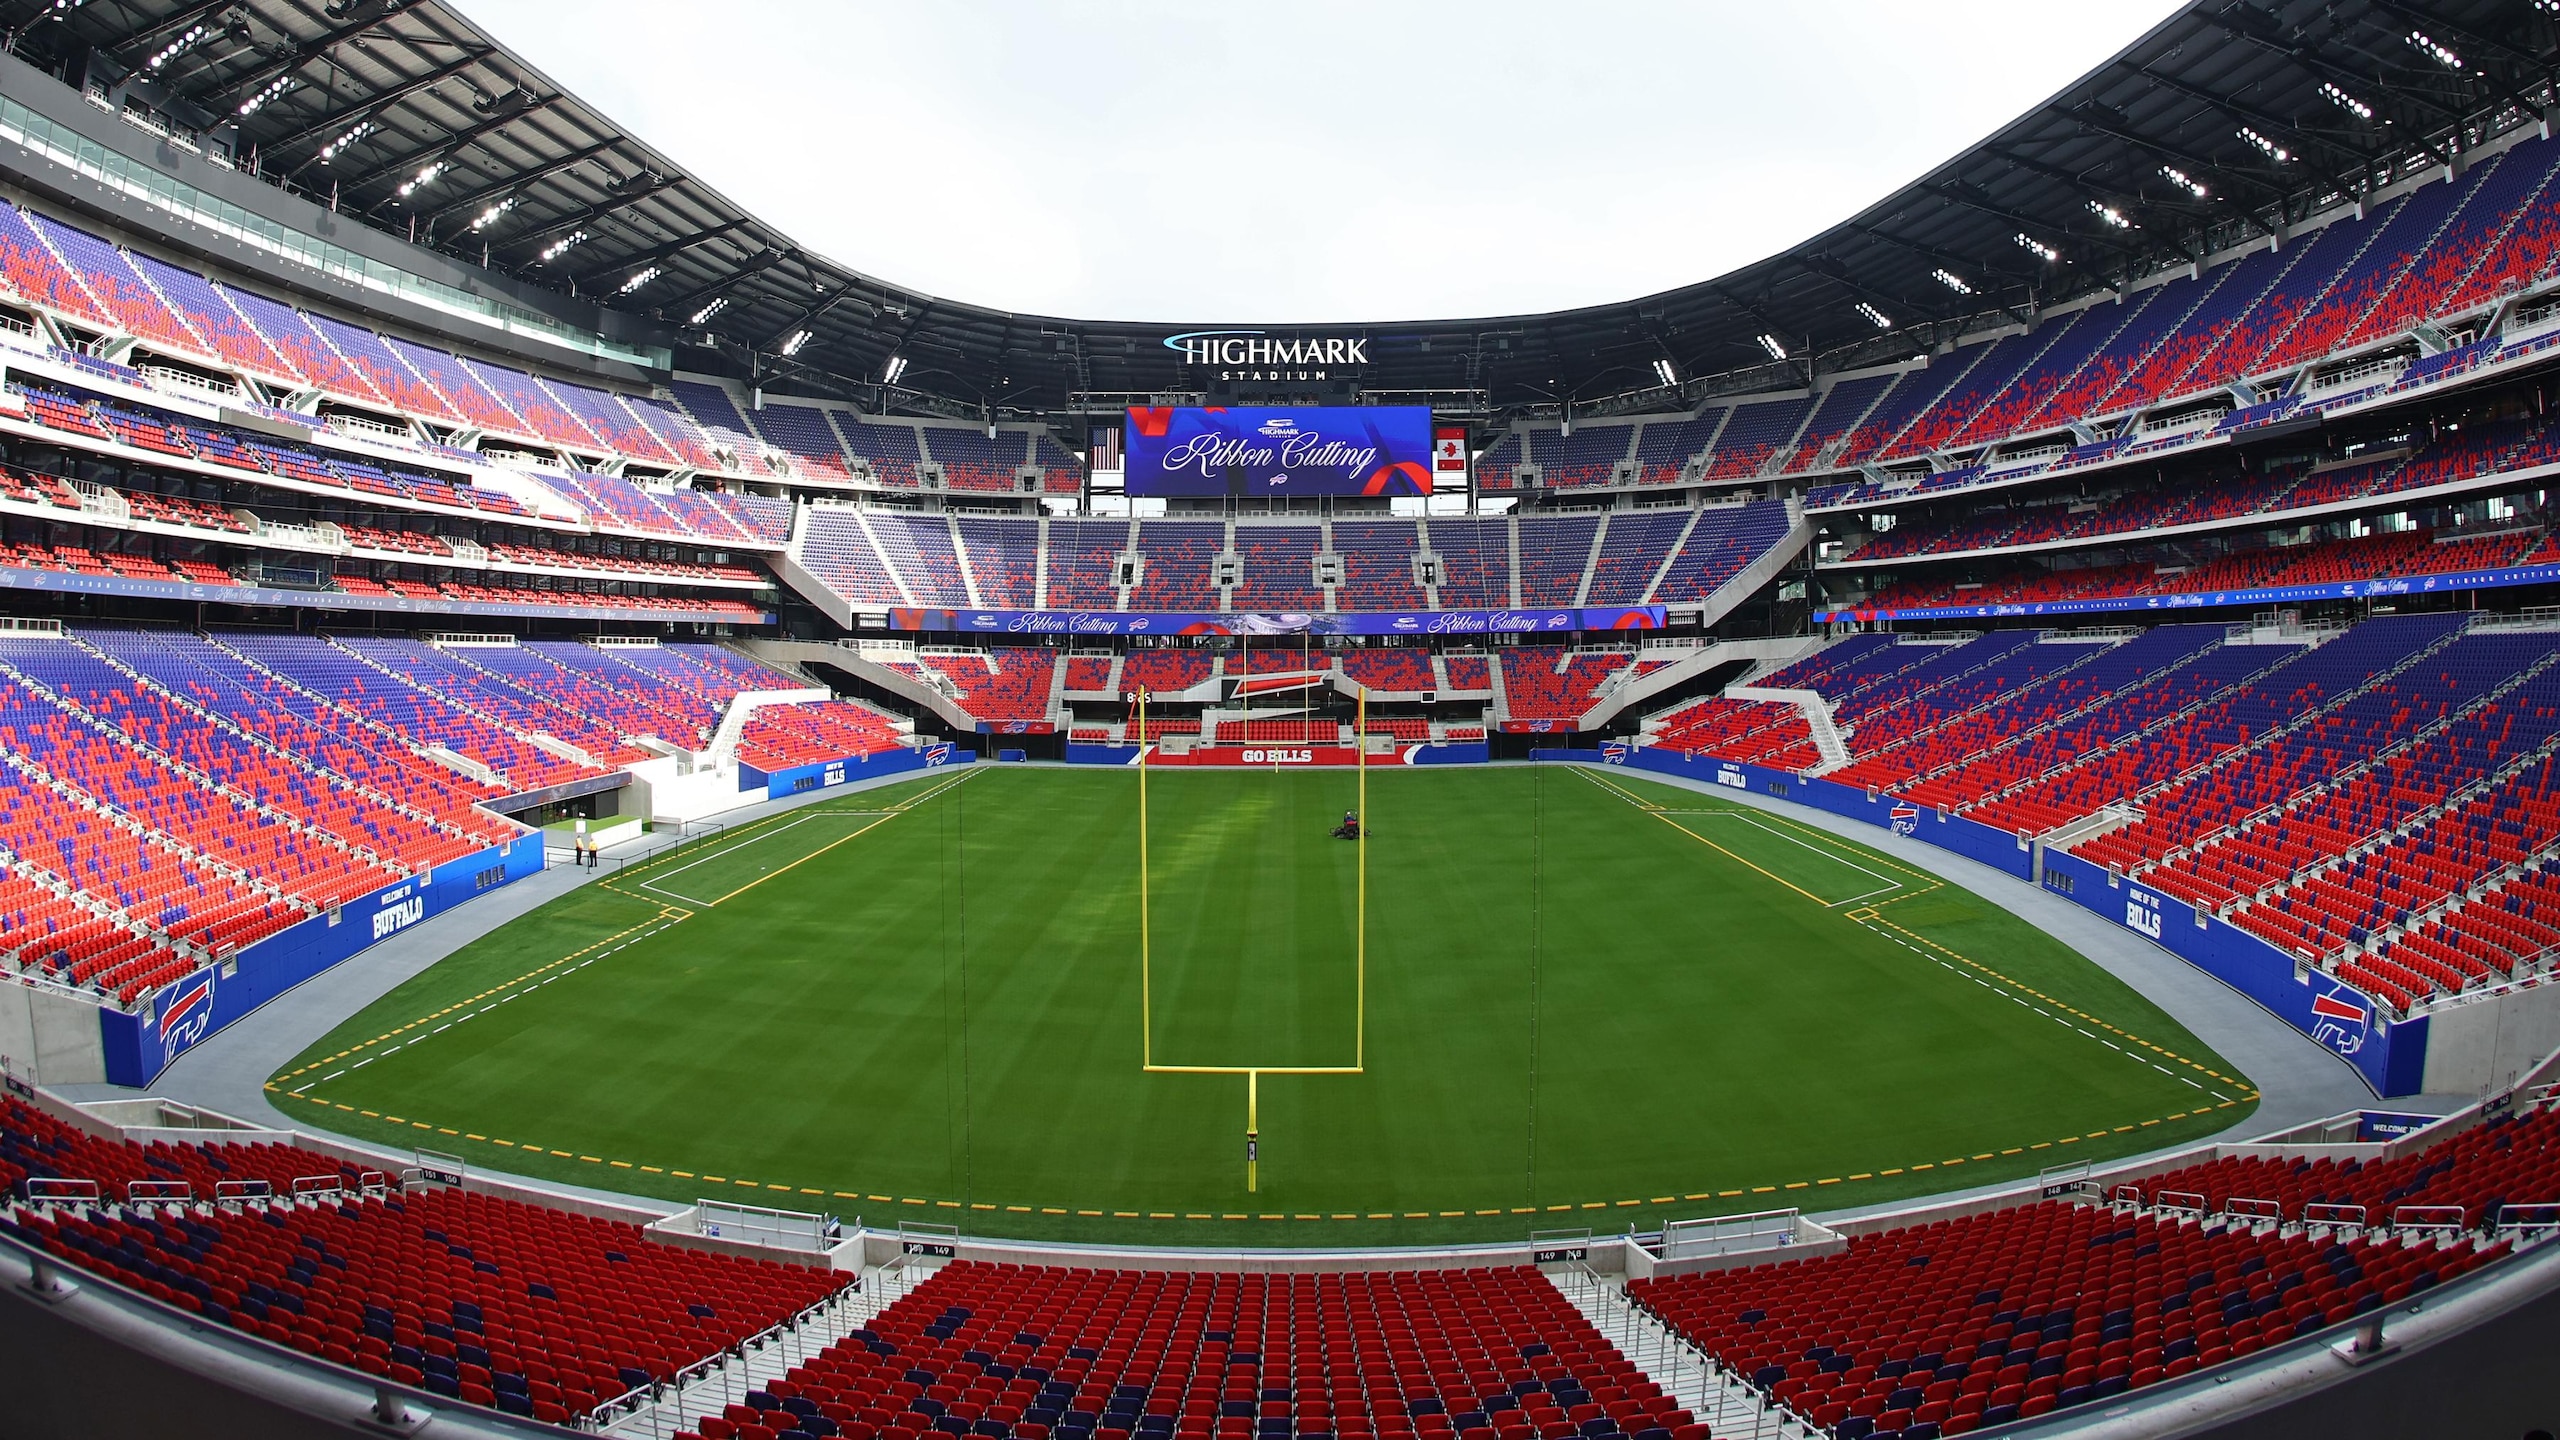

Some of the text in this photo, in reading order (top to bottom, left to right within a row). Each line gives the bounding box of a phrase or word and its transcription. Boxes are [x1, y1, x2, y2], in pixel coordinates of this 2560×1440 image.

[1185, 337, 1368, 365] HIGHMARK
[1221, 371, 1327, 381] STADIUM
[1163, 431, 1376, 480] Ribbon Cutting
[1008, 612, 1118, 634] Ribbon Cutting
[1427, 611, 1539, 634] Ribbon Cutting
[1242, 750, 1312, 762] GO BILLS
[824, 769, 845, 786] BILLS
[1717, 769, 1746, 788] BUFFALO
[373, 895, 423, 940] BUFFALO
[2126, 901, 2161, 939] BILLS
[2373, 1123, 2408, 1133] WELCOME
[425, 1170, 457, 1183] 151 150
[2047, 1186, 2061, 1196] 148
[934, 1246, 950, 1255] 149
[1540, 1252, 1556, 1260] 149
